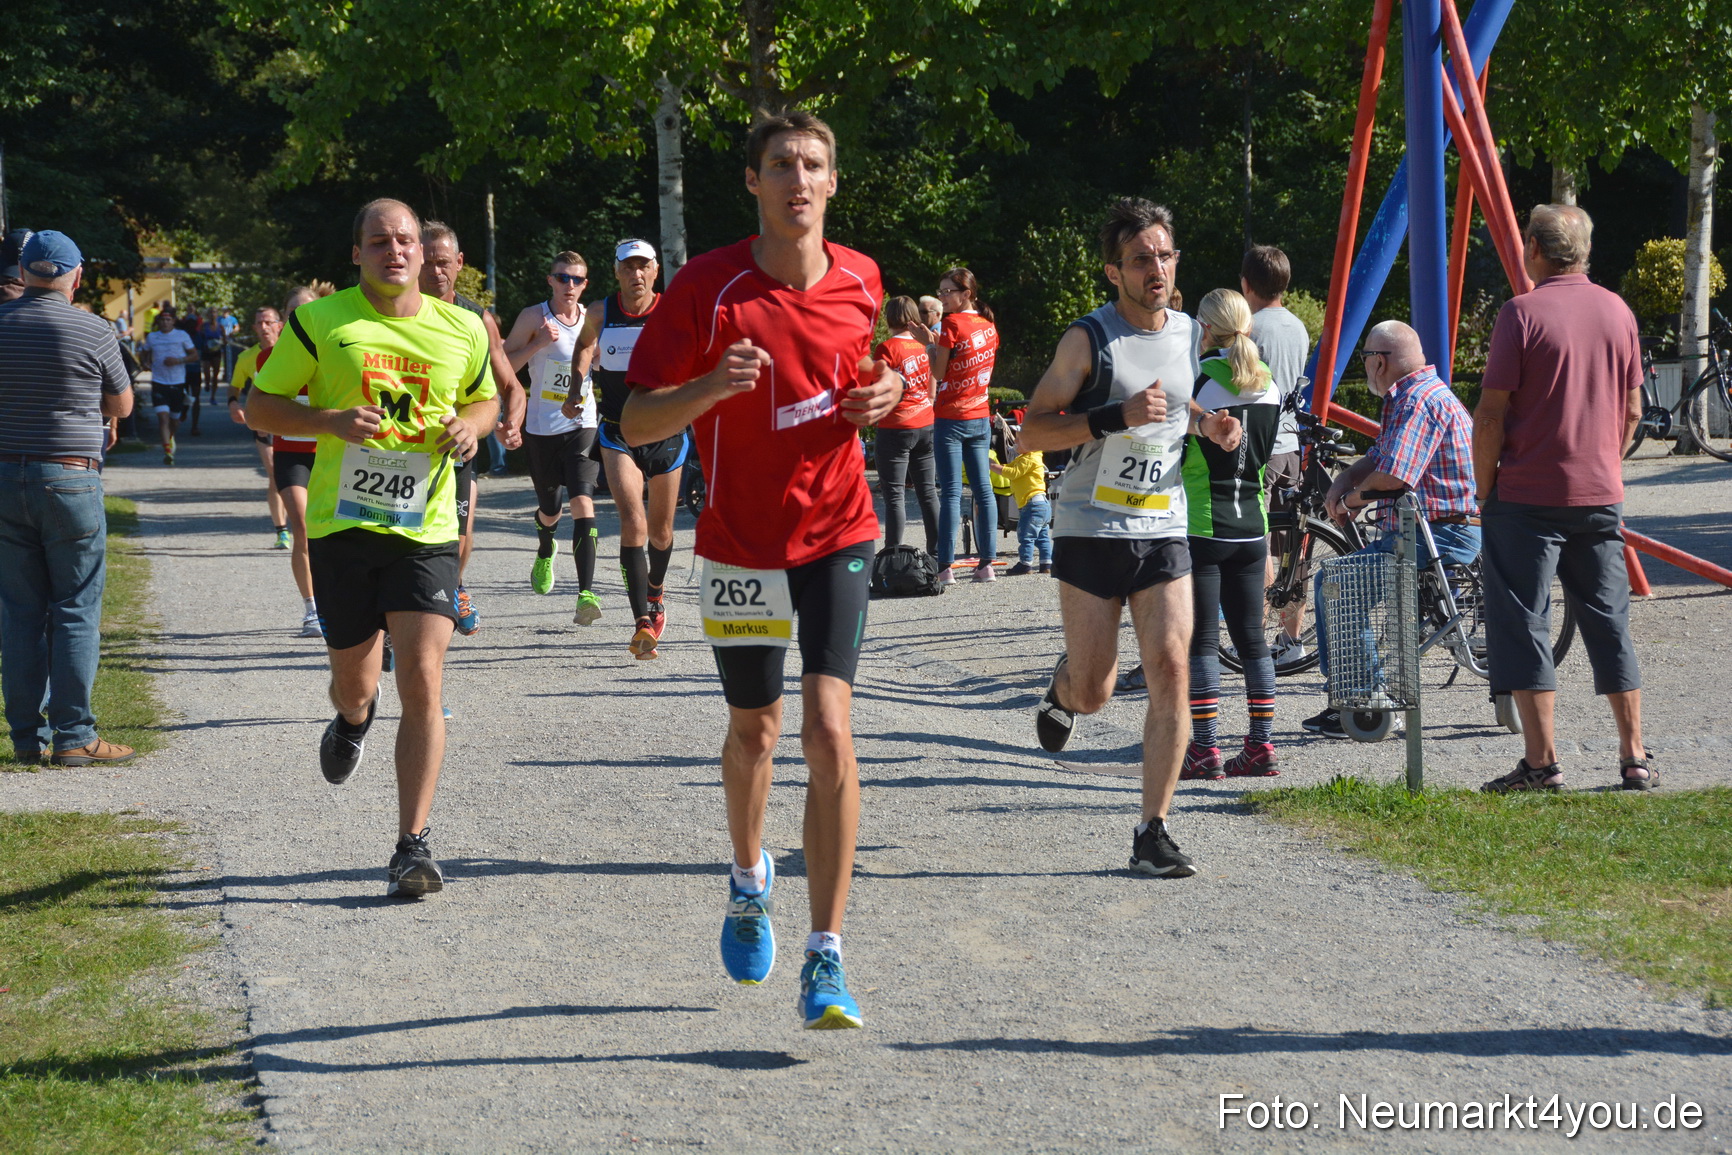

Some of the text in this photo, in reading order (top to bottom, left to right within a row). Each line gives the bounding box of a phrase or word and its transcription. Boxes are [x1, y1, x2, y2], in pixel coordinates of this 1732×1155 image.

[363, 352, 432, 374] Müller
[554, 373, 571, 388] 20
[379, 390, 413, 422] M
[1130, 441, 1163, 453] BOCK
[368, 455, 407, 468] BOCK
[1119, 456, 1162, 483] 216
[352, 469, 416, 500] 2248
[1114, 481, 1132, 490] PARTL
[356, 495, 401, 508] PARTL Neumarkt
[1126, 494, 1146, 506] Karl
[360, 506, 402, 524] Dominik
[710, 578, 766, 606] 262
[723, 623, 768, 635] Markus
